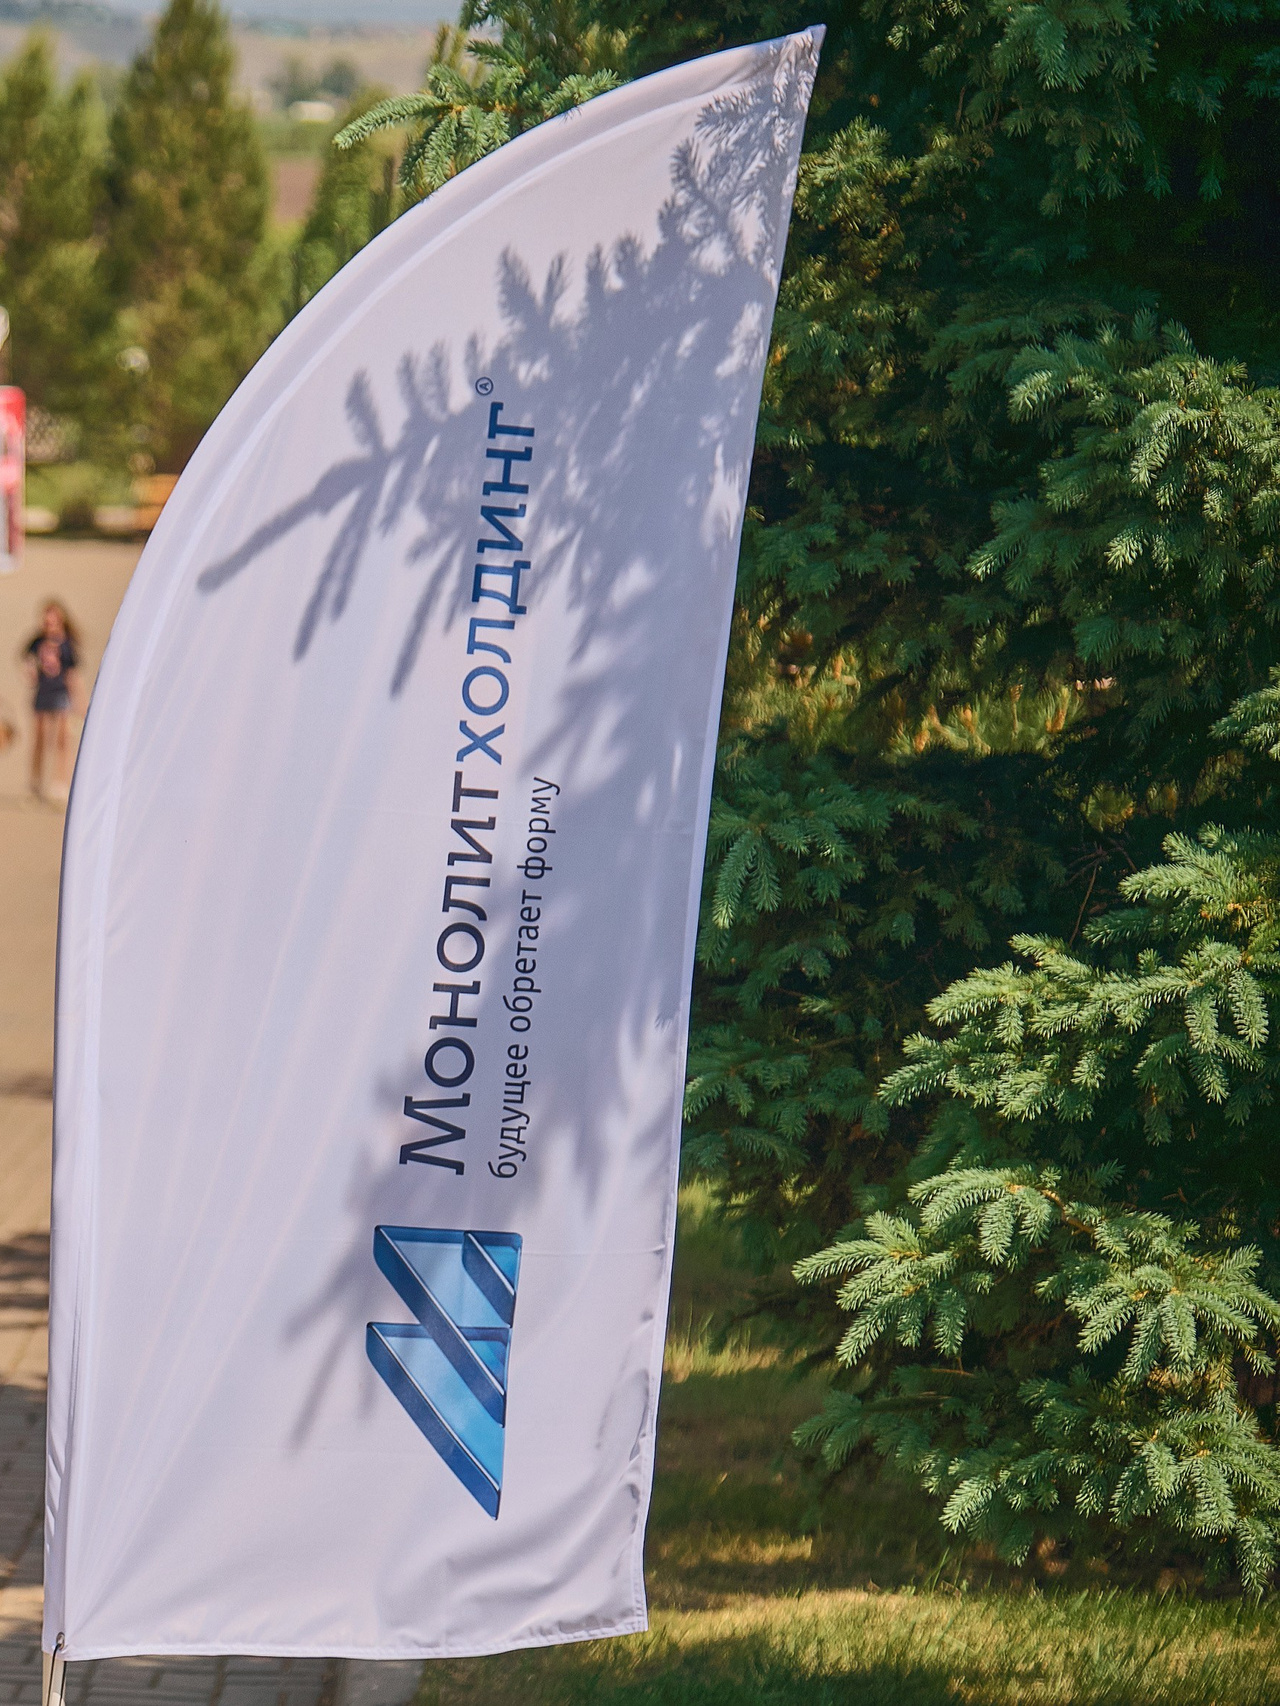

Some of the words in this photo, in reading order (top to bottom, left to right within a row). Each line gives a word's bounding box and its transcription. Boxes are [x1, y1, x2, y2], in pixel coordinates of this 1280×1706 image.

[516, 776, 561, 880] форму
[502, 889, 542, 1033] обретает
[487, 1043, 531, 1180] будущее
